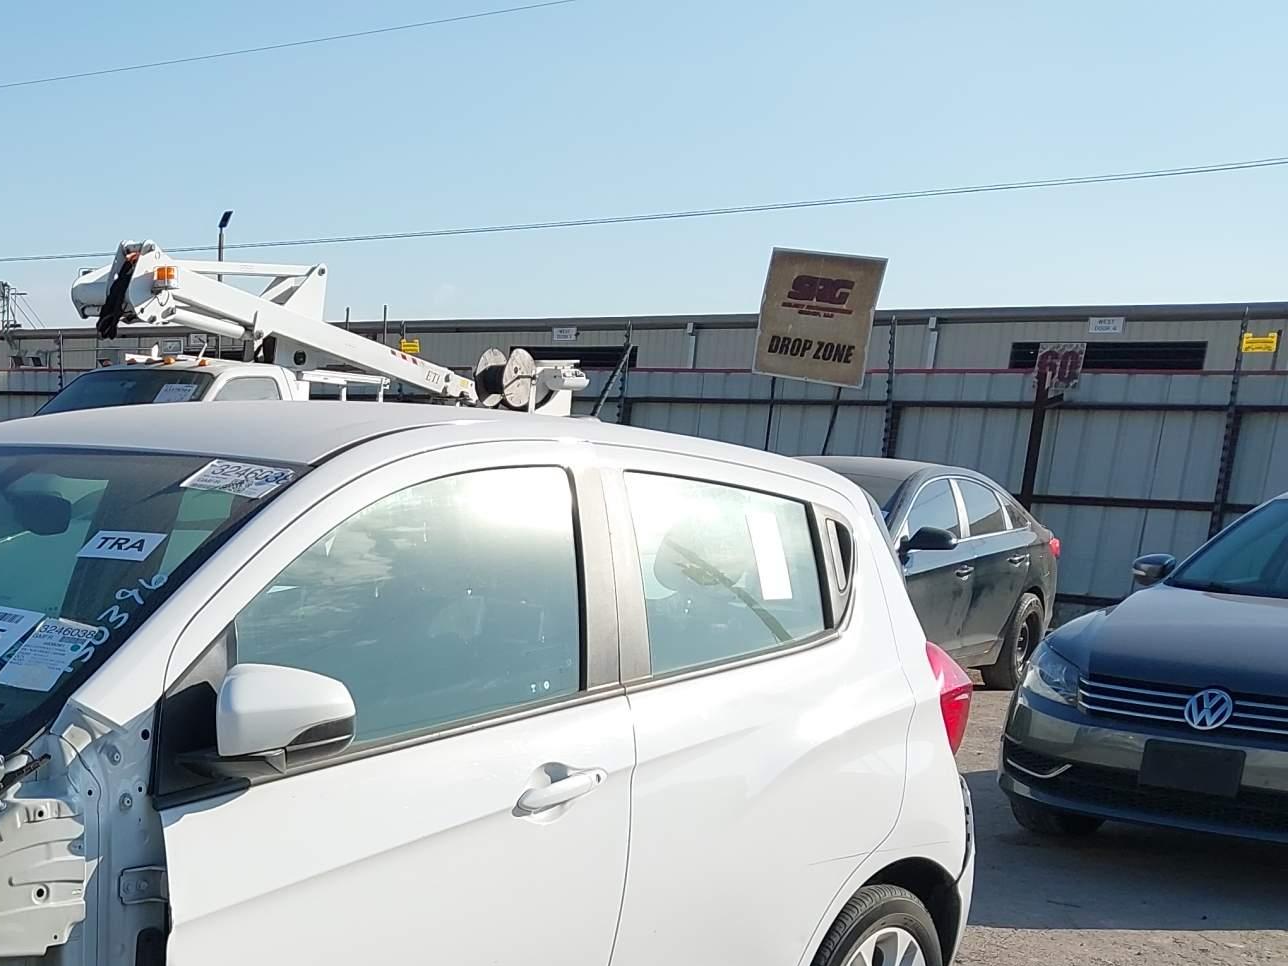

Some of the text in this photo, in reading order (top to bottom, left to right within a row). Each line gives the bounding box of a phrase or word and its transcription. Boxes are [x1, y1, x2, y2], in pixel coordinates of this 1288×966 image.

[767, 335, 855, 364] DROP ZONE
[95, 536, 146, 553] TRA
